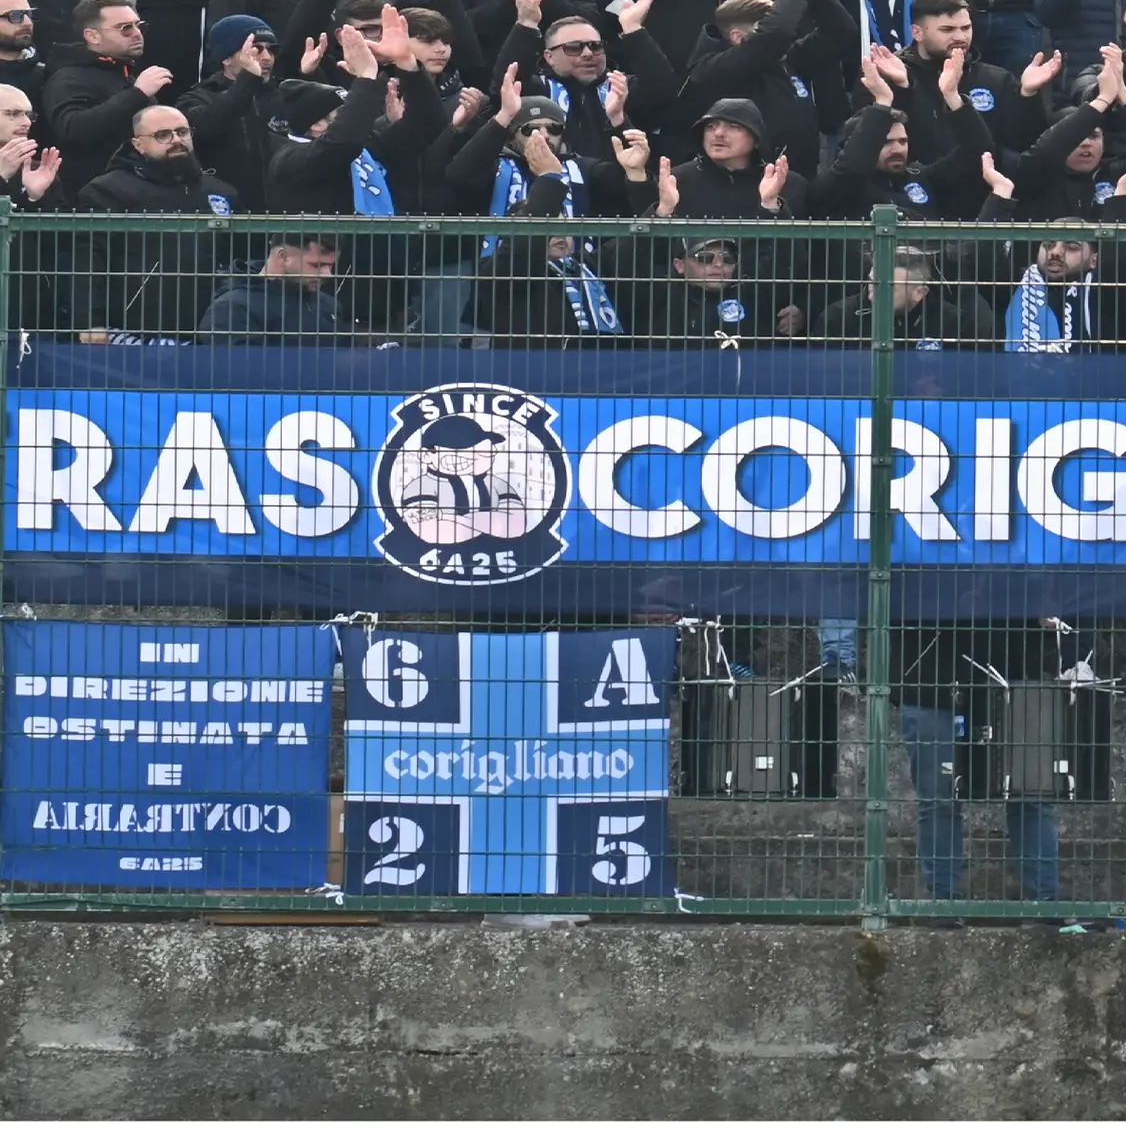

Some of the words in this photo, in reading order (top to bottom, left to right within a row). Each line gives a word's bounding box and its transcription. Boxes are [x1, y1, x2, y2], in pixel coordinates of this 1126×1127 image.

[418, 393, 541, 425] SINCE
[16, 408, 360, 538] RAS
[419, 548, 518, 575] 6A25
[139, 642, 200, 663] IN
[362, 638, 430, 708] 6
[583, 637, 661, 708] A
[15, 675, 325, 703] DIREZIONE
[23, 716, 309, 746] OSTINATA
[147, 763, 183, 786] E
[384, 738, 635, 795] corigliano
[119, 857, 204, 872] 6A25
[364, 816, 426, 886] 2
[592, 815, 651, 885] 5
